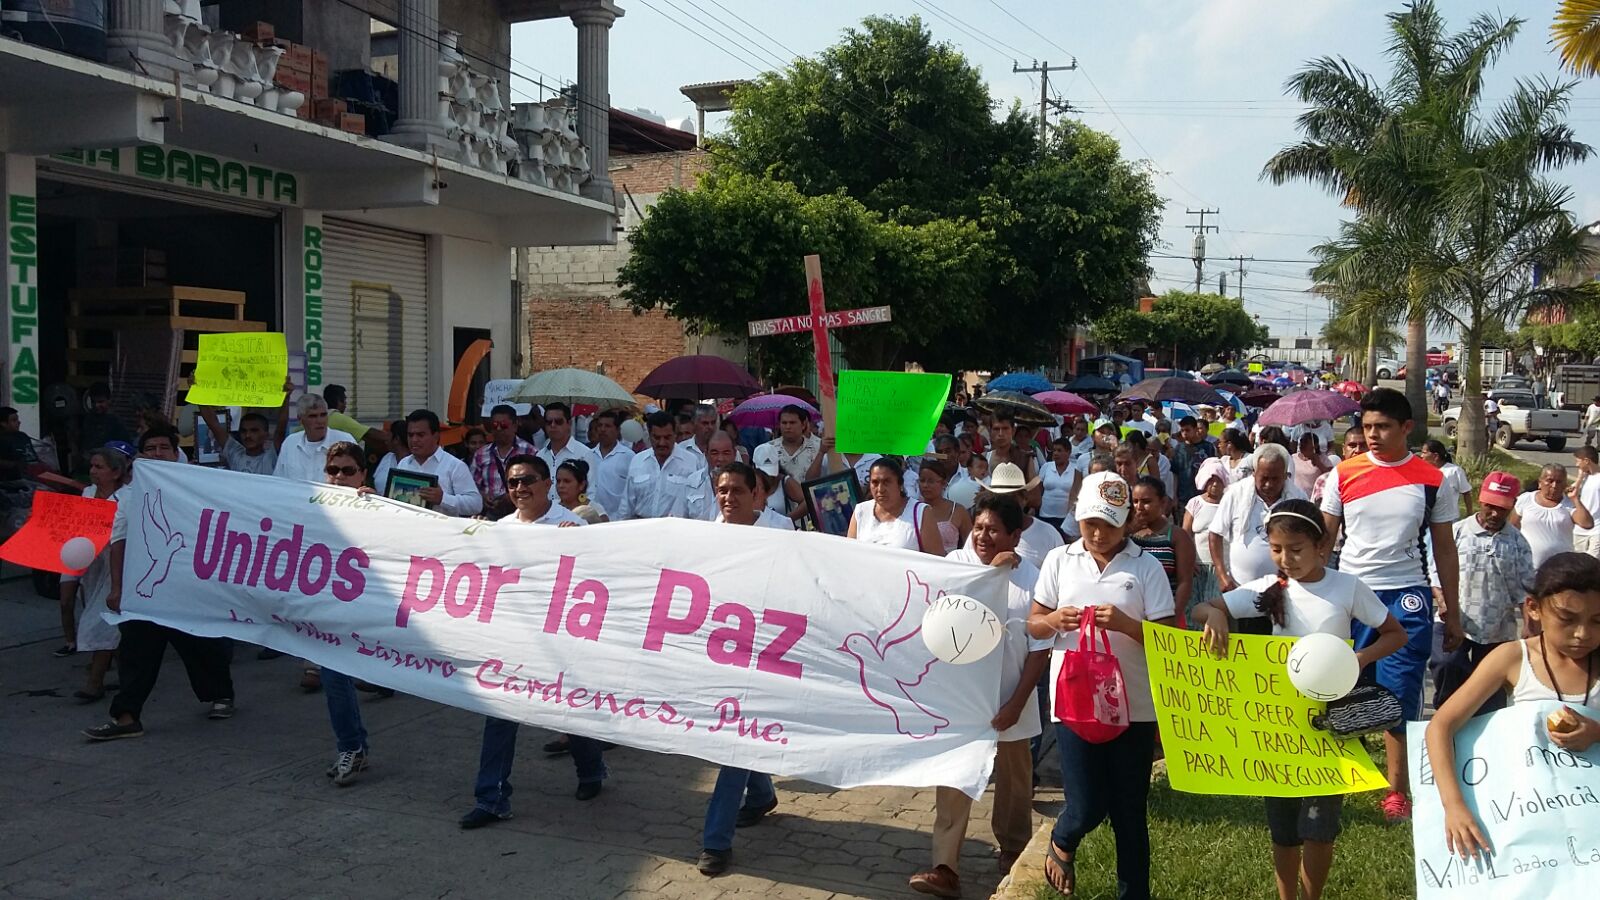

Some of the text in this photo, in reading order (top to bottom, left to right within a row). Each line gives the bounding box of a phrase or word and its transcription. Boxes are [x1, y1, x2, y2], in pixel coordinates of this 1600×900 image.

[135, 144, 297, 204] BARATA
[9, 194, 38, 405] ESTUFAS
[304, 225, 323, 386] ROPEROS
[797, 316, 813, 328] NO
[819, 313, 842, 328] MAS
[847, 308, 887, 324] SANGRE
[193, 508, 808, 680] Unidos por la Paz
[1153, 629, 1177, 654] NO
[1184, 635, 1248, 662] BAA
[1265, 641, 1294, 664] CO
[1164, 657, 1281, 696] HABLAR DE
[476, 659, 695, 733] Cárdenas,
[708, 697, 789, 745] Pue.
[1160, 684, 1190, 711] UNO
[1198, 693, 1238, 720] DEBE
[1244, 700, 1299, 729] CREER
[1171, 714, 1356, 757] ELLA Y TRABAJAR
[1183, 750, 1368, 787] PARA CONSEGUIRLA
[1420, 856, 1480, 889] Villa
